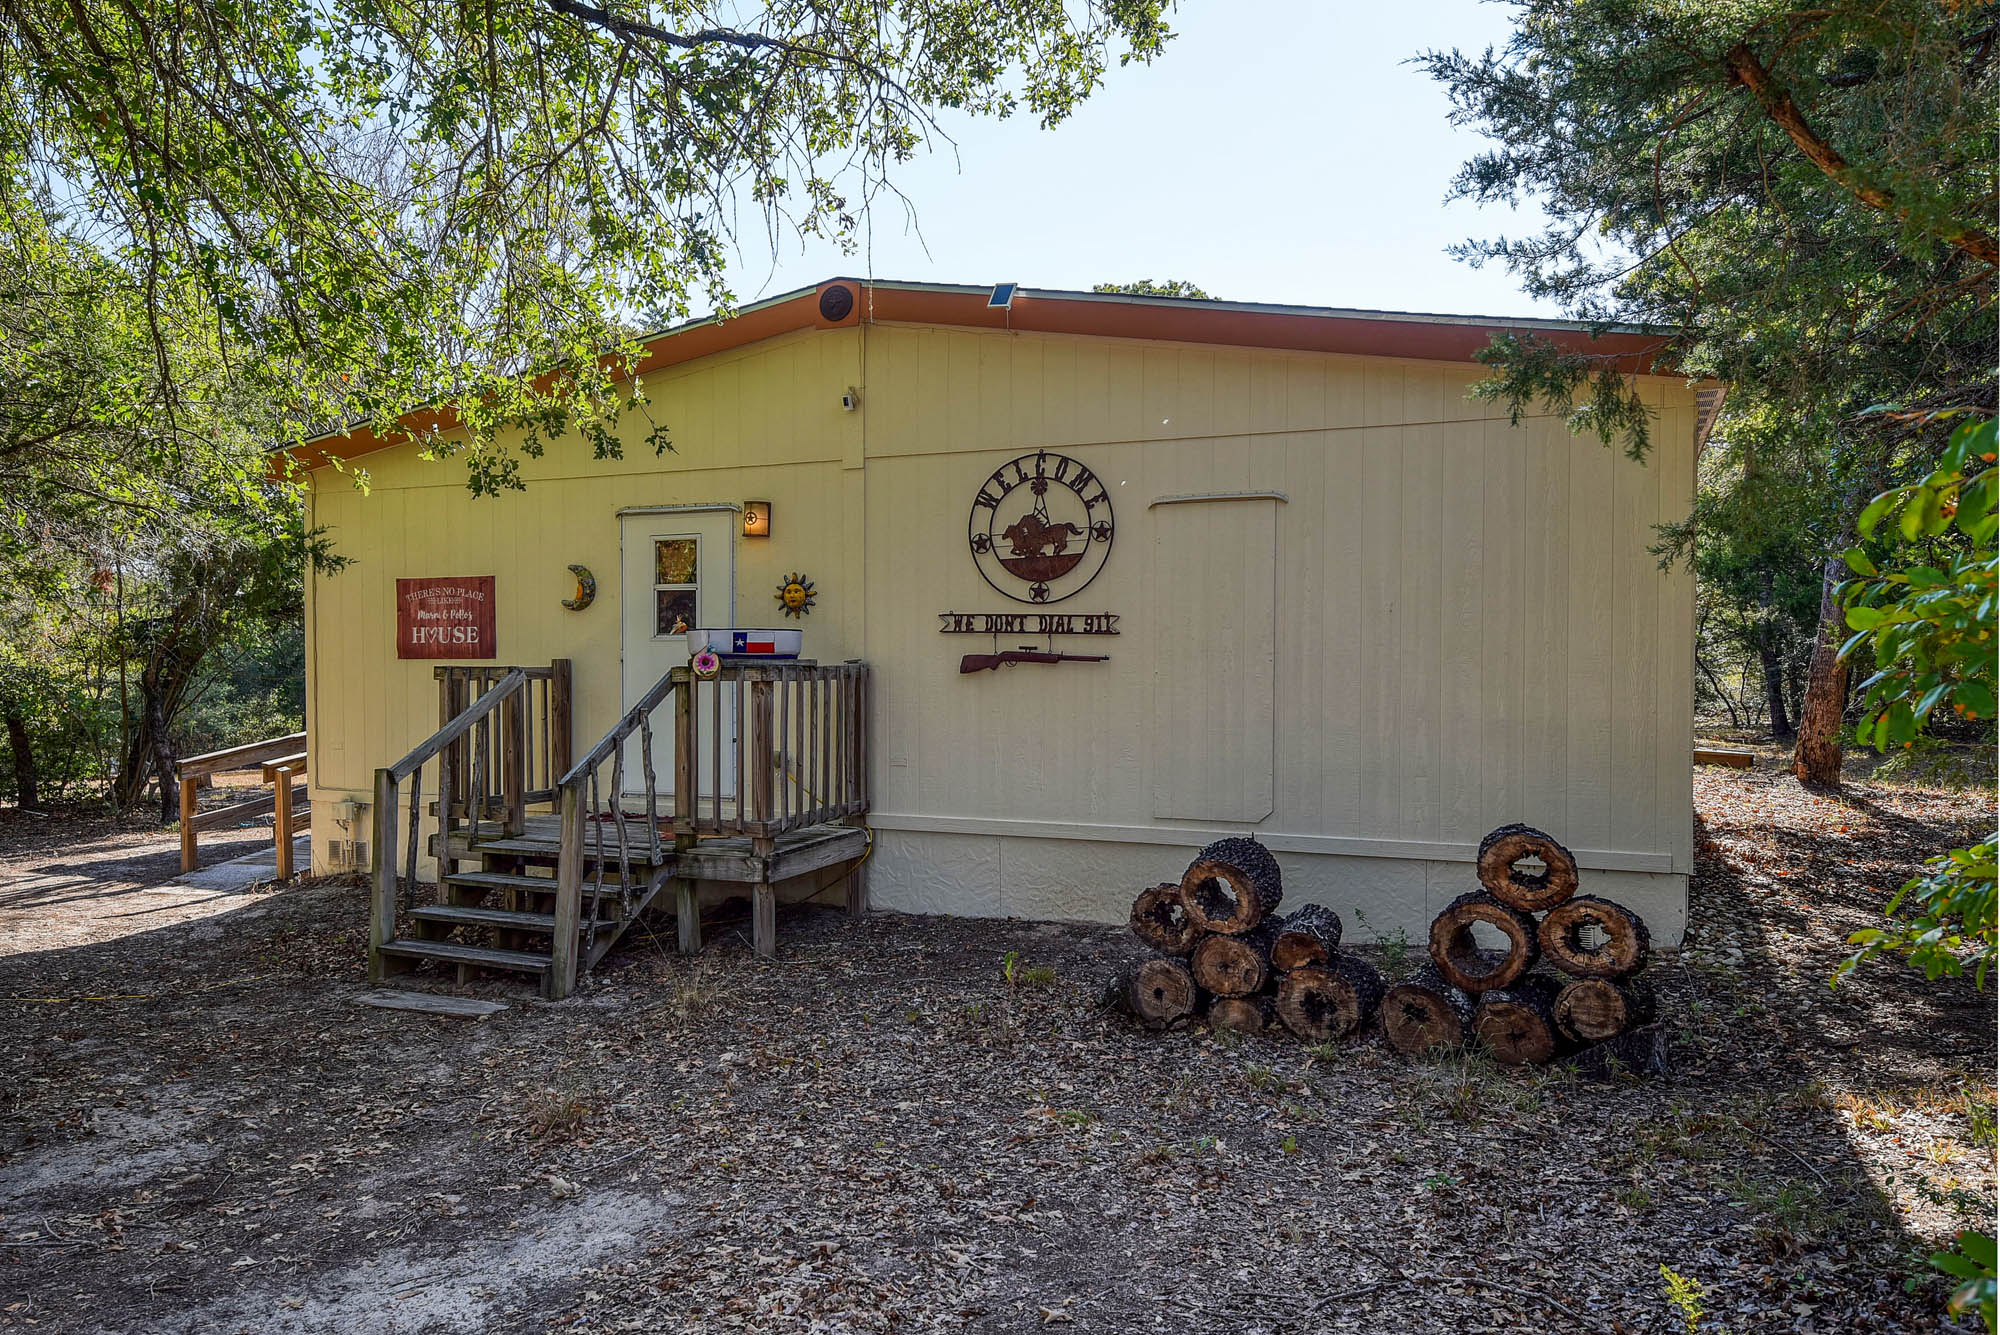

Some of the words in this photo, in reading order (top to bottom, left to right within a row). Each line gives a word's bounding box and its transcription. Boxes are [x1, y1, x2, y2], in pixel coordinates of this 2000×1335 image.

[975, 453, 1108, 510] WELCOME
[442, 587, 455, 596] NO
[457, 588, 484, 601] PLACE
[953, 615, 975, 633] WE
[1039, 615, 1074, 633] DIAL
[1083, 615, 1113, 634] 911
